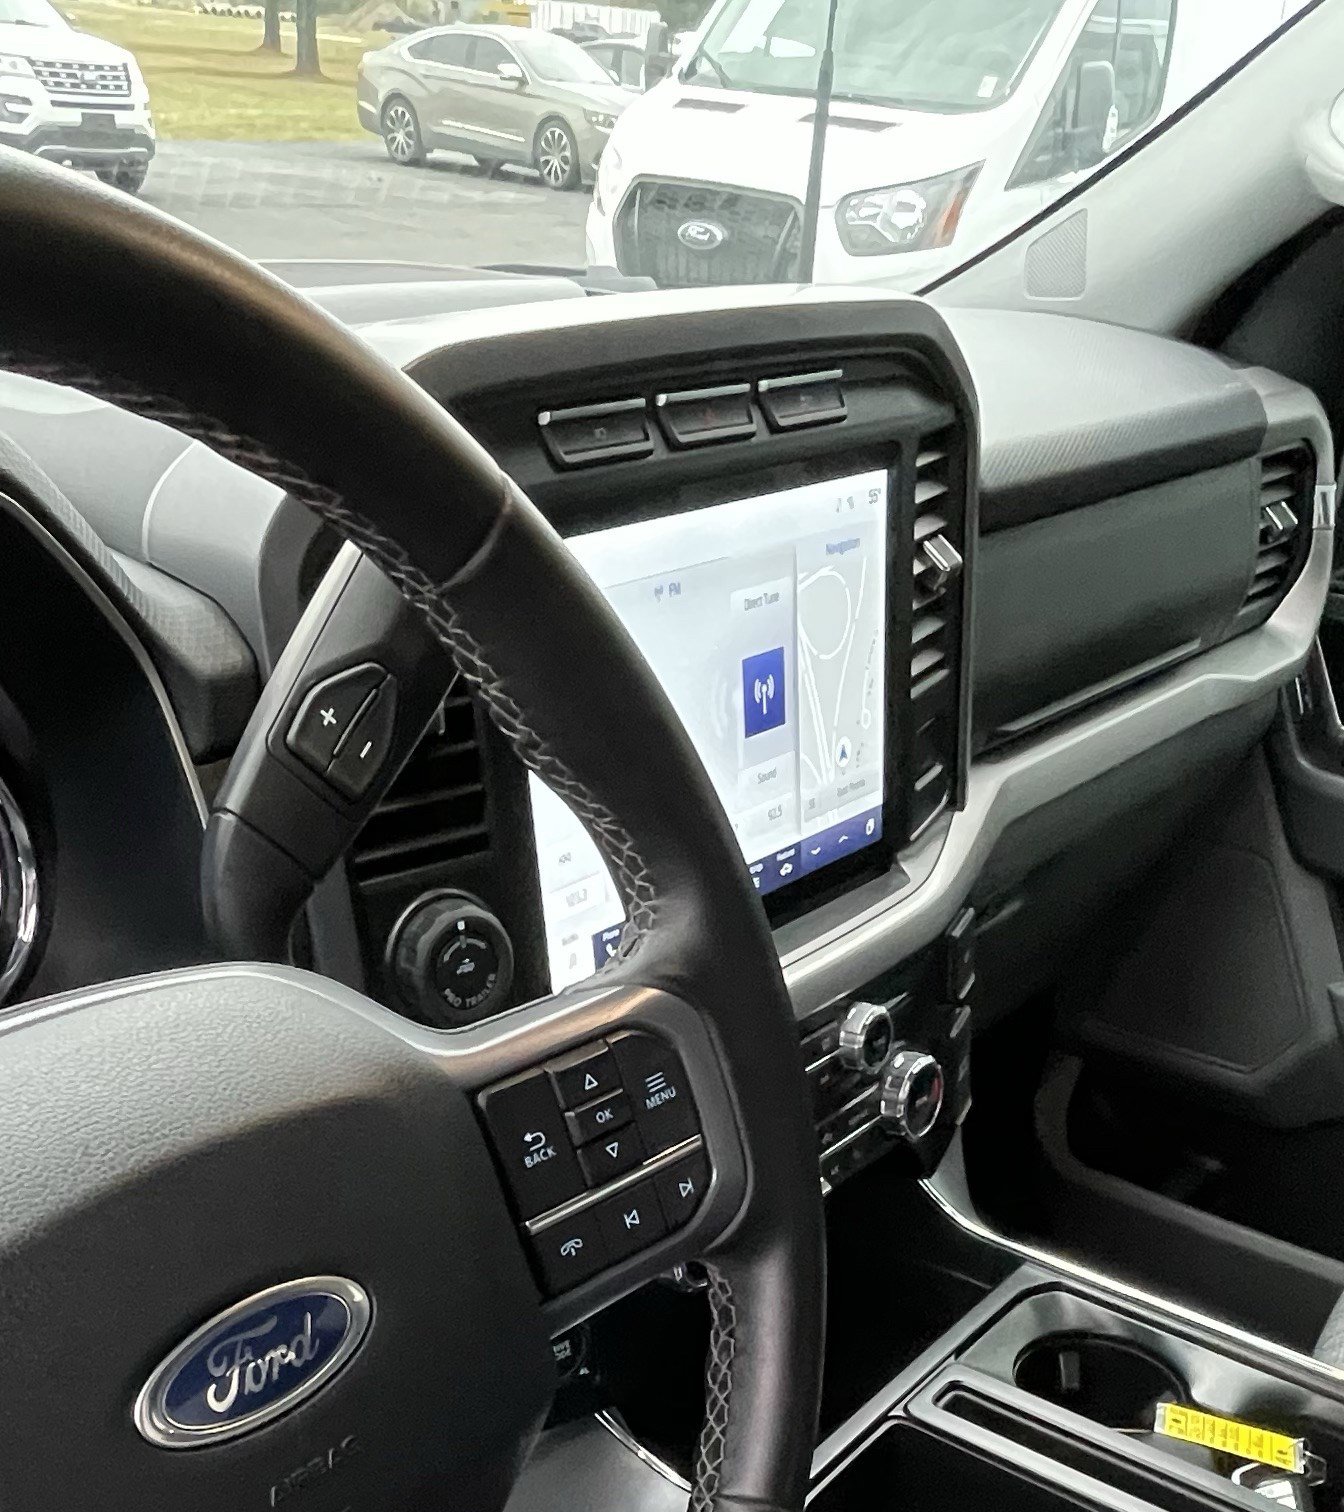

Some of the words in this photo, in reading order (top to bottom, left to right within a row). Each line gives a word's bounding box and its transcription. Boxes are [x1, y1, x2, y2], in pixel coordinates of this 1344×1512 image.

[645, 1086, 677, 1110] MENU
[595, 1108, 615, 1124] OK
[524, 1146, 557, 1169] BACK
[207, 1311, 320, 1413] Ford
